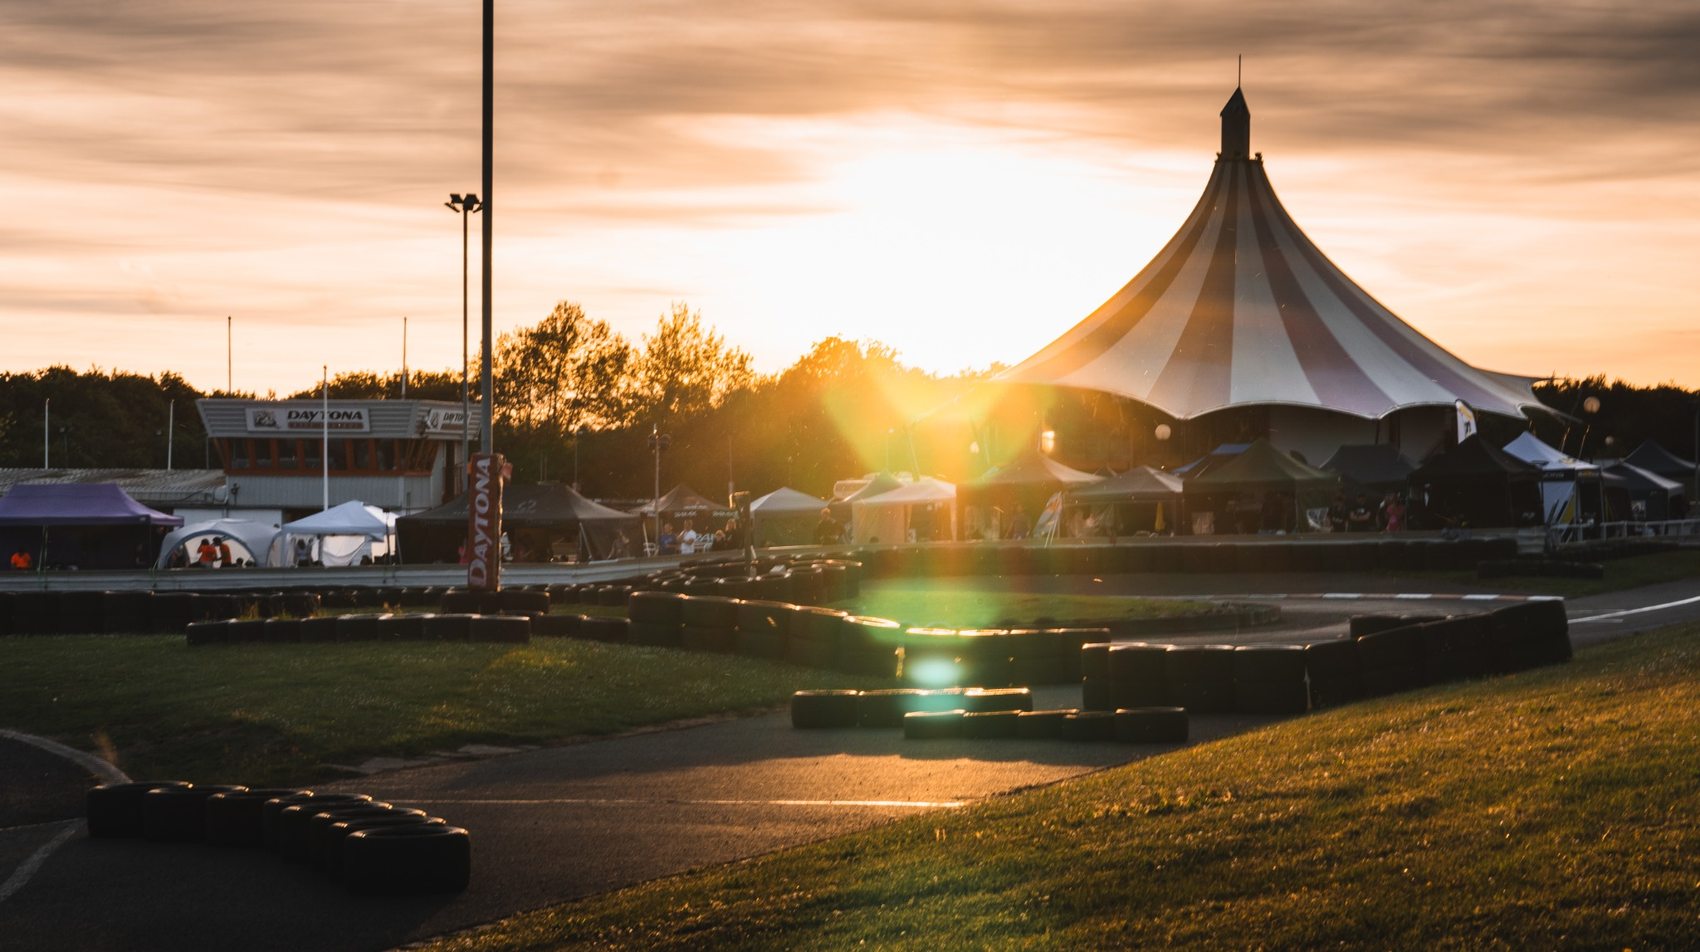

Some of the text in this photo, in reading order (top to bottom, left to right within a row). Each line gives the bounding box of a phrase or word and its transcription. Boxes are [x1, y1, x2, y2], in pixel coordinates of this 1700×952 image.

[287, 410, 363, 423] DAYTONA
[443, 411, 470, 422] DAYTO
[469, 457, 492, 586] DAYTONA
